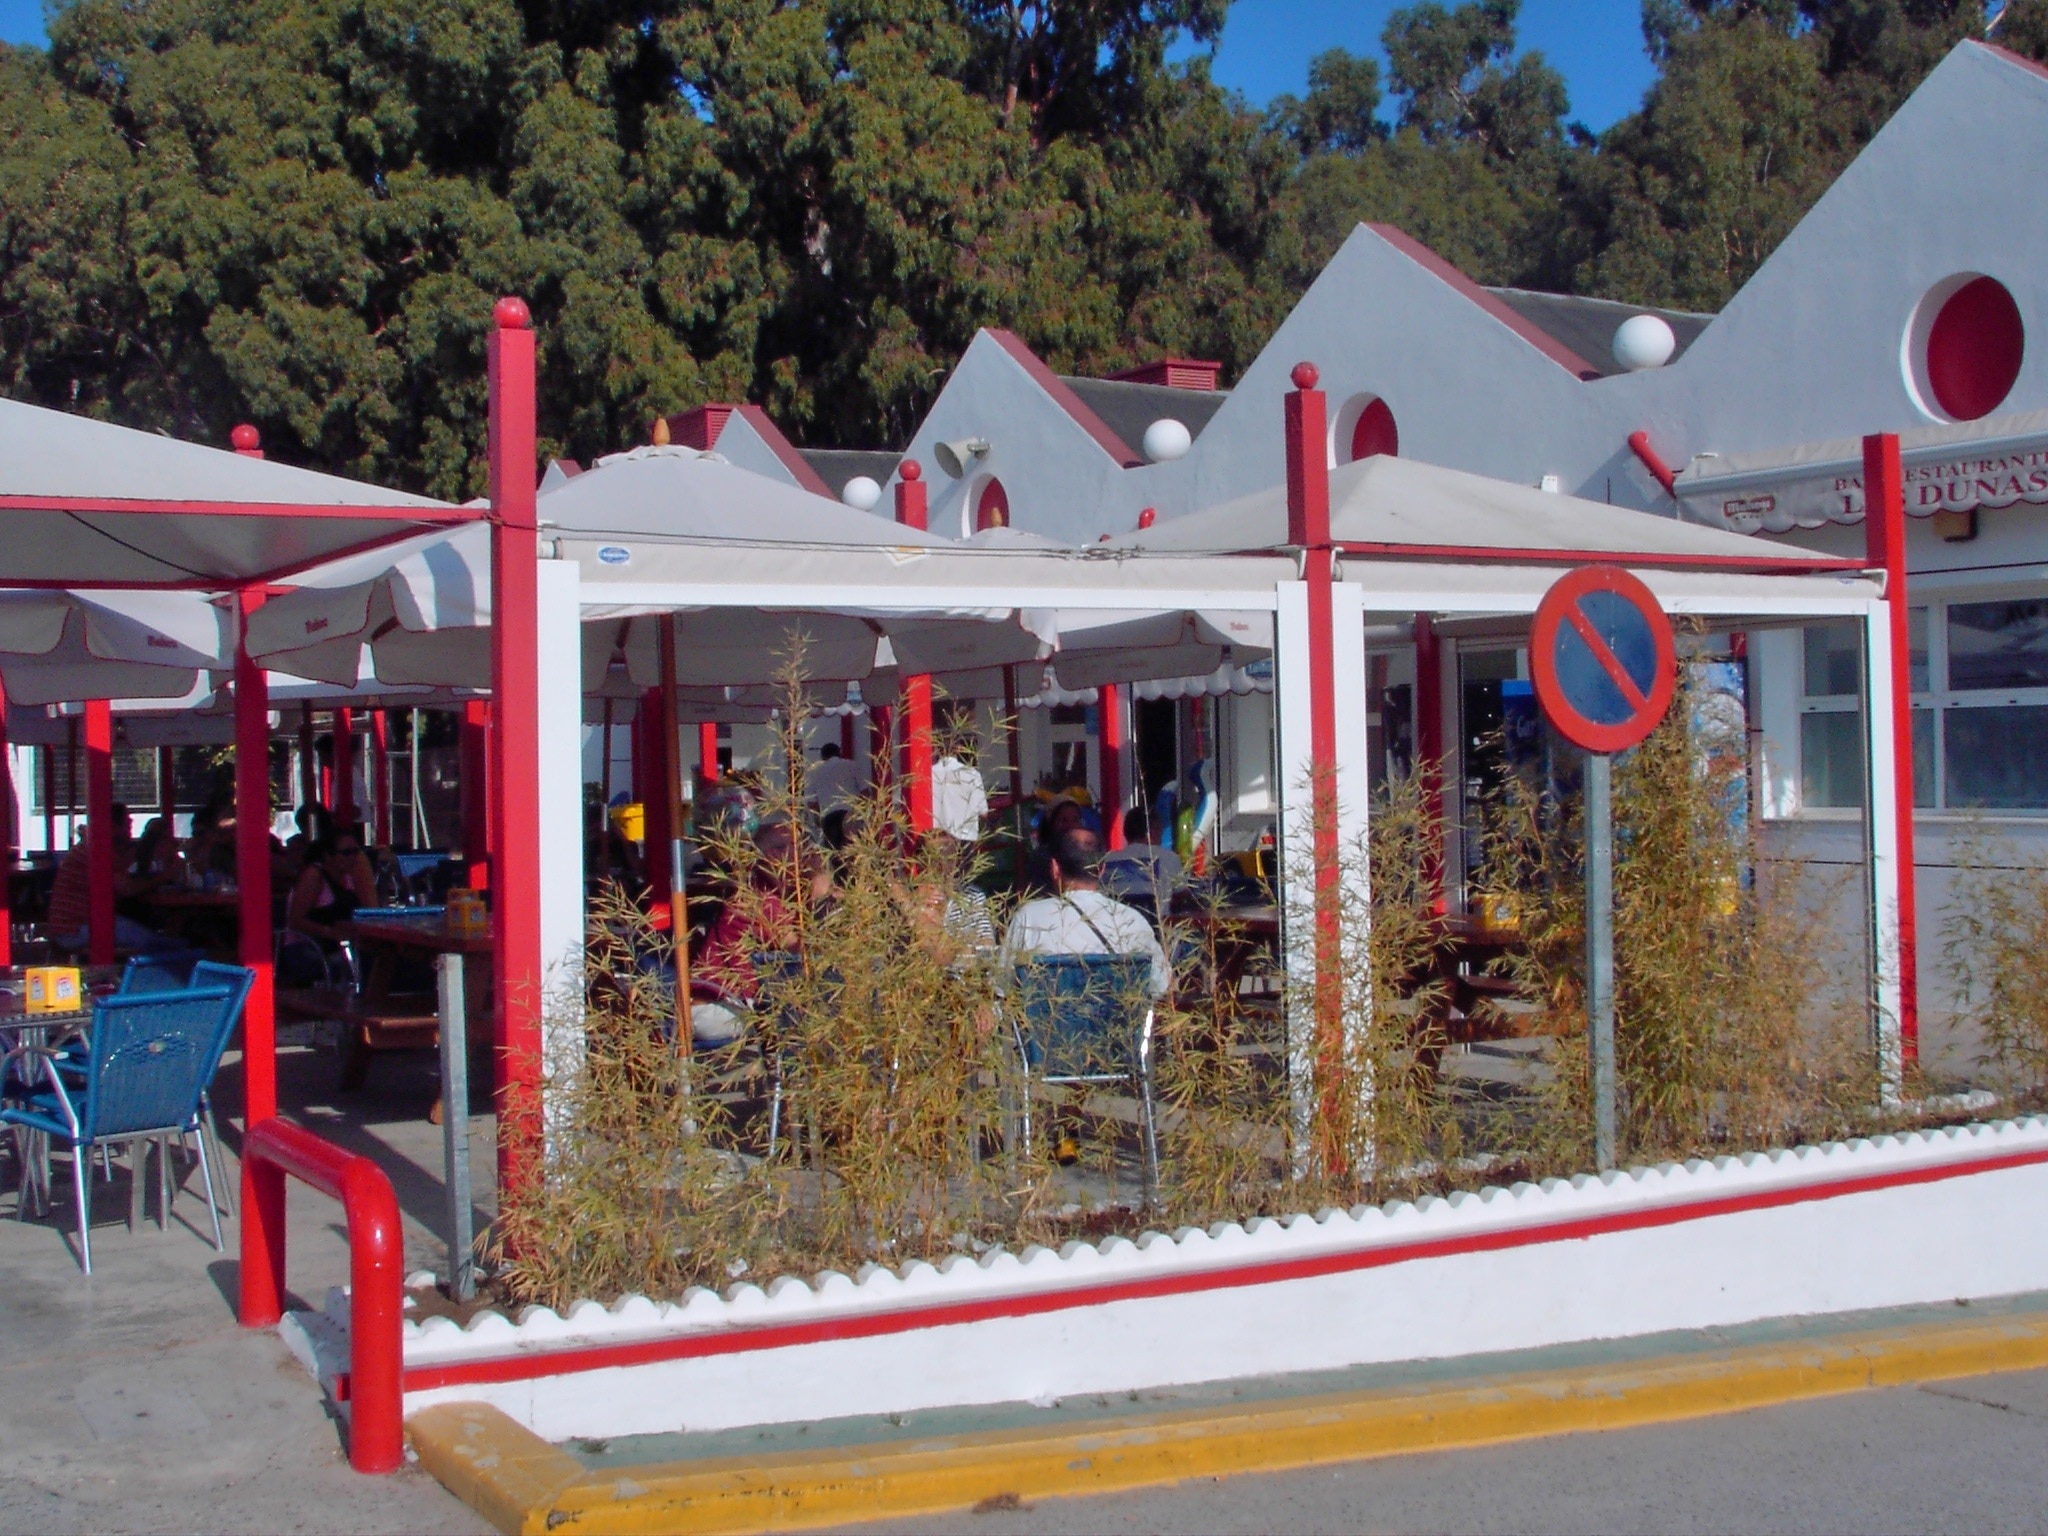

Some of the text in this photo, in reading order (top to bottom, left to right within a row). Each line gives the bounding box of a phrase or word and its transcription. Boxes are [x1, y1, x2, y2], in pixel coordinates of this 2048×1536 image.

[1835, 452, 2048, 491] BA ESTAURANT
[1918, 470, 2048, 506] DUNAS
